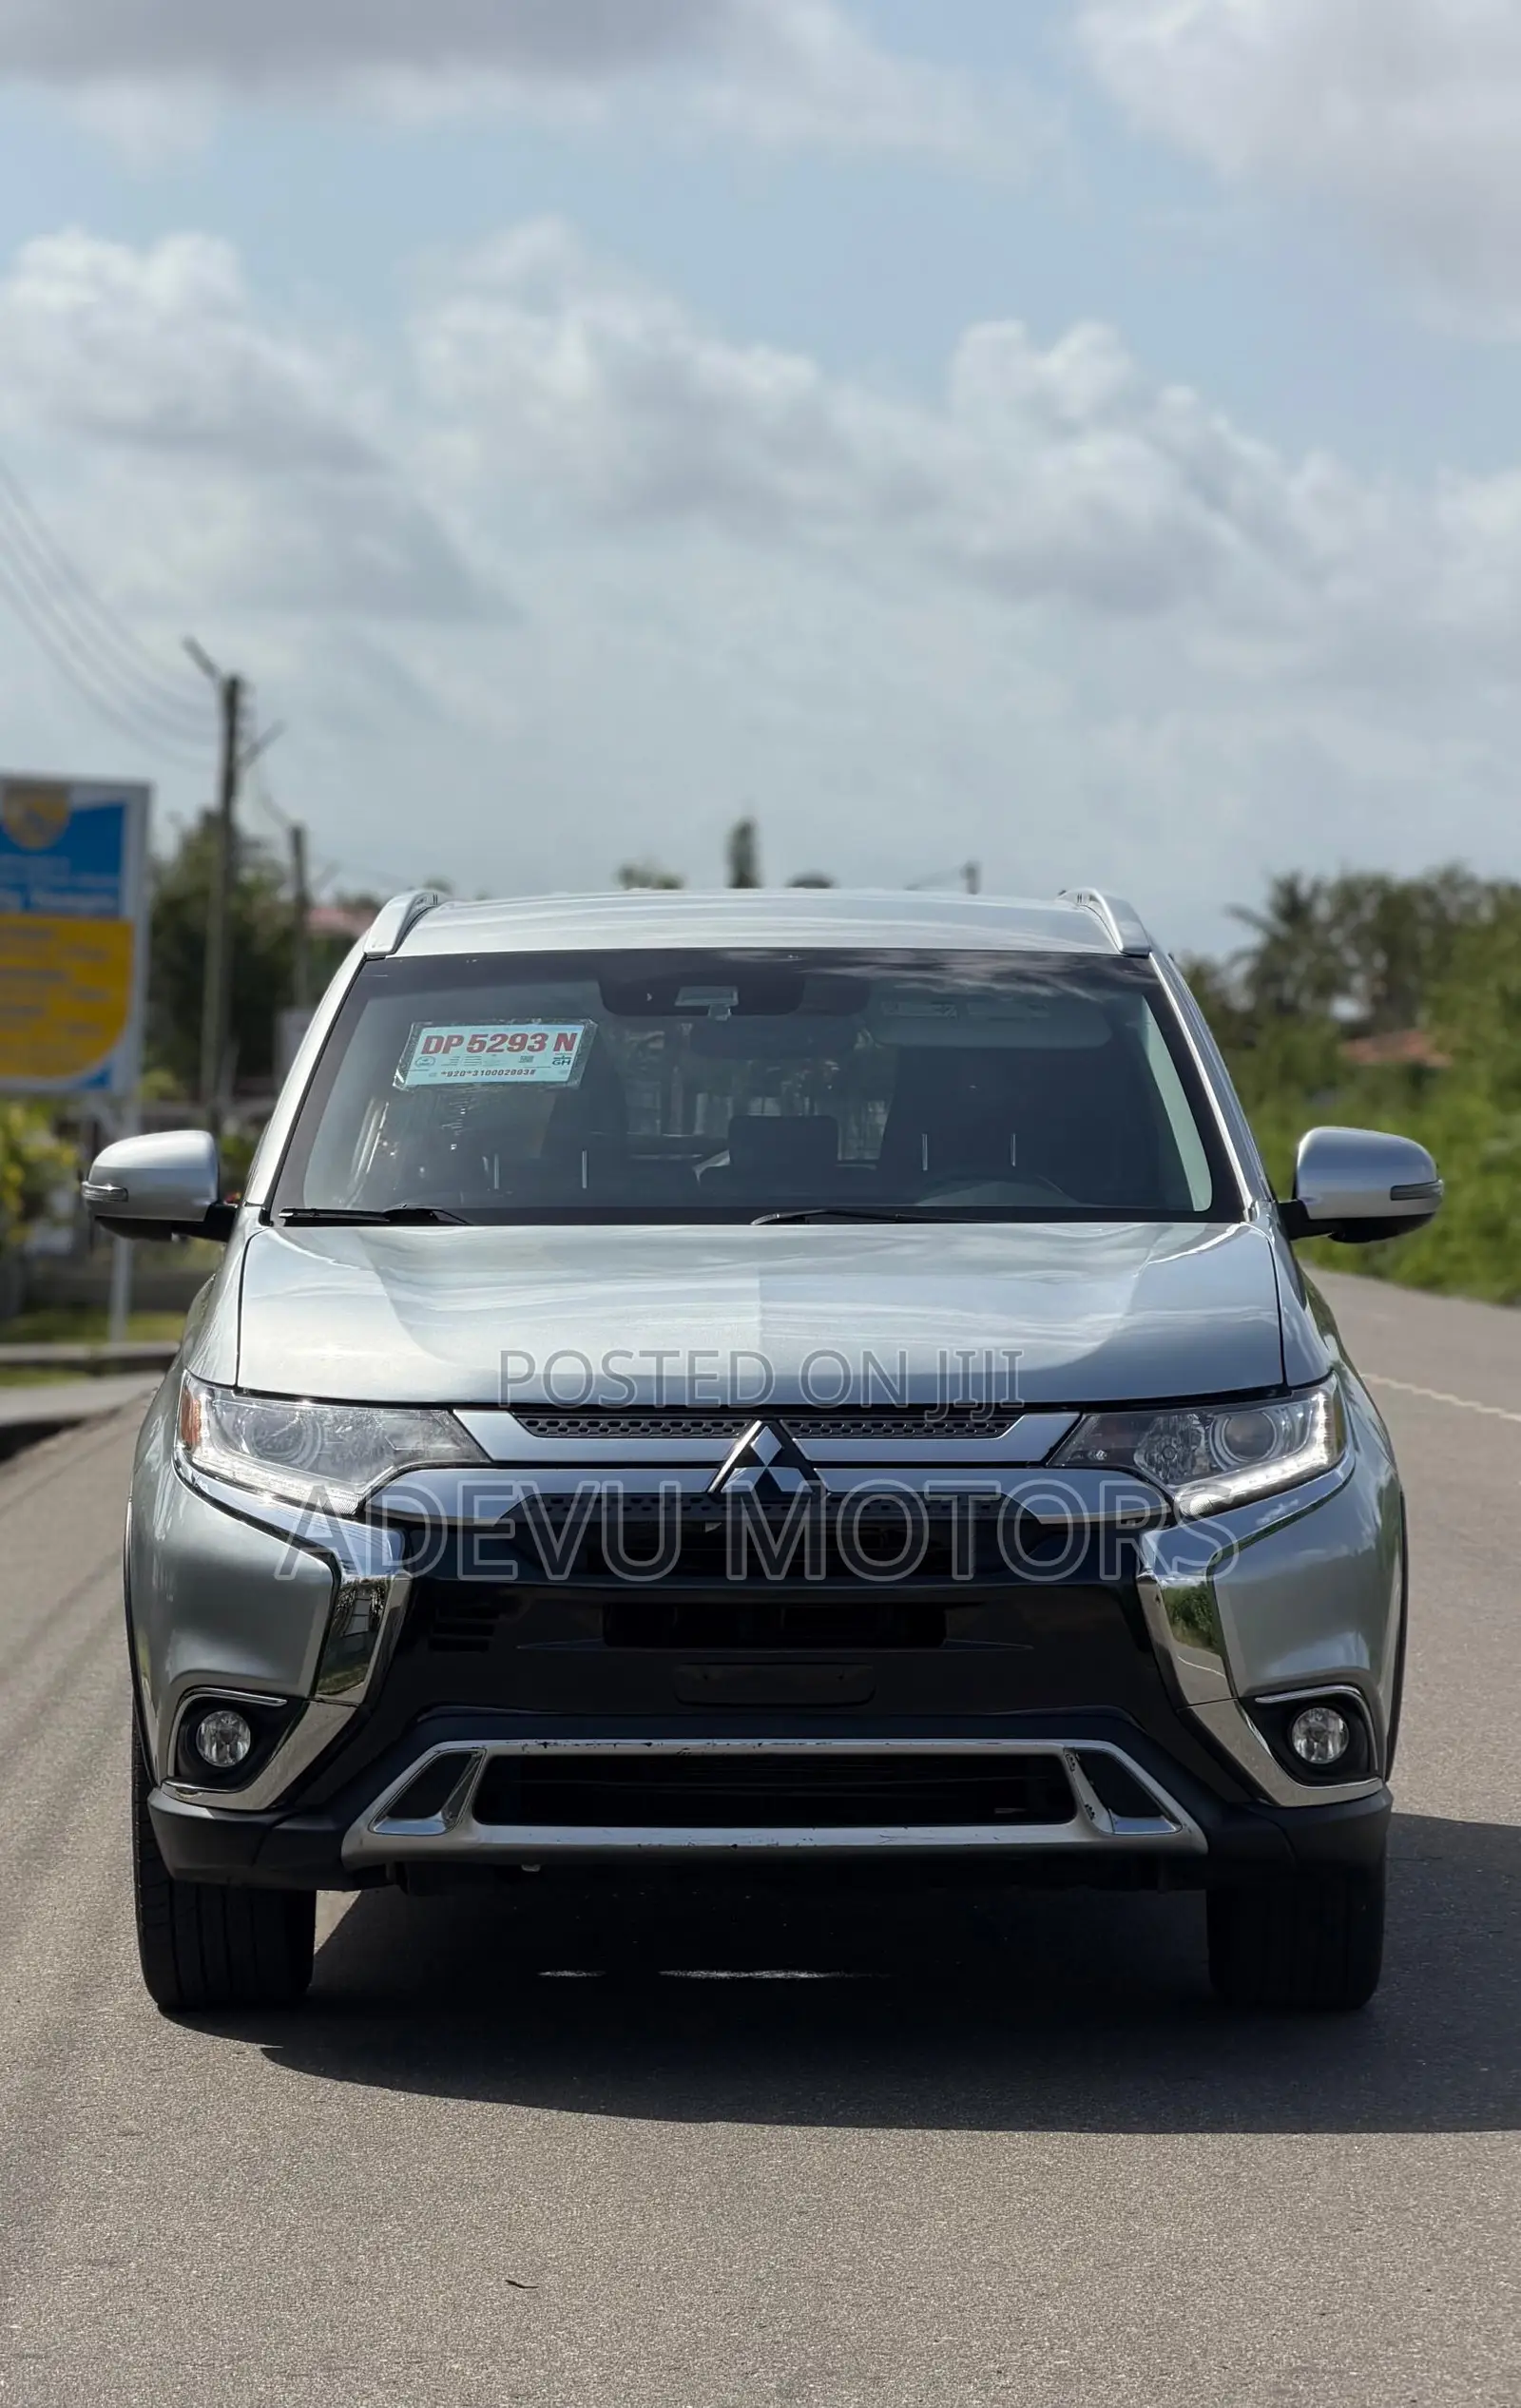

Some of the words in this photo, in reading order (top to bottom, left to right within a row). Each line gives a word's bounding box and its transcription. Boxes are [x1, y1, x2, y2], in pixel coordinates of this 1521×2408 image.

[421, 1034, 465, 1055] DP
[466, 1032, 549, 1053] 5293
[553, 1032, 578, 1052] N
